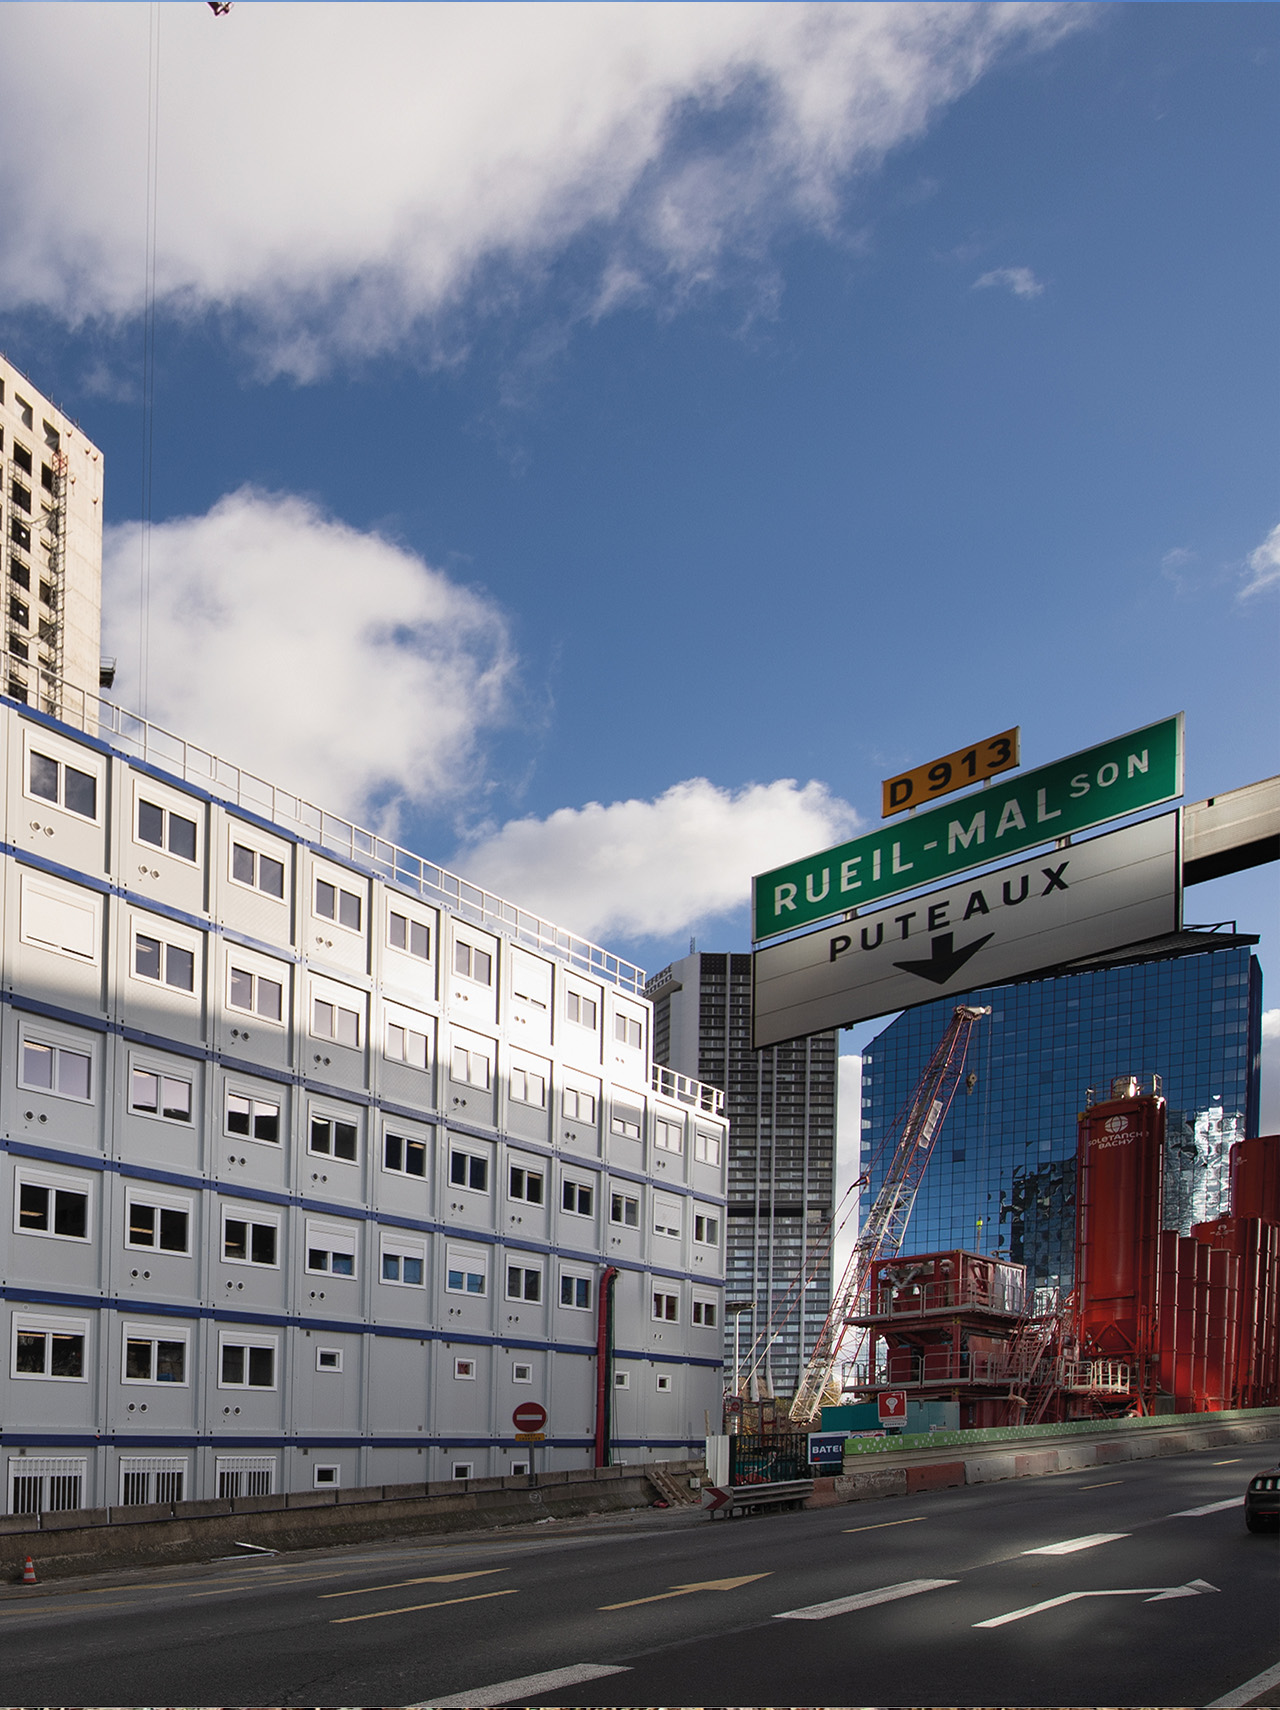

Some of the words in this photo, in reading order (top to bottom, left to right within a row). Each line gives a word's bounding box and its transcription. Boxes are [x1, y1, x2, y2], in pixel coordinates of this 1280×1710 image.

[888, 777, 914, 808] D
[927, 737, 1012, 792] 913
[829, 860, 1070, 963] PUTEAUX
[1098, 1138, 1134, 1150] BACHY
